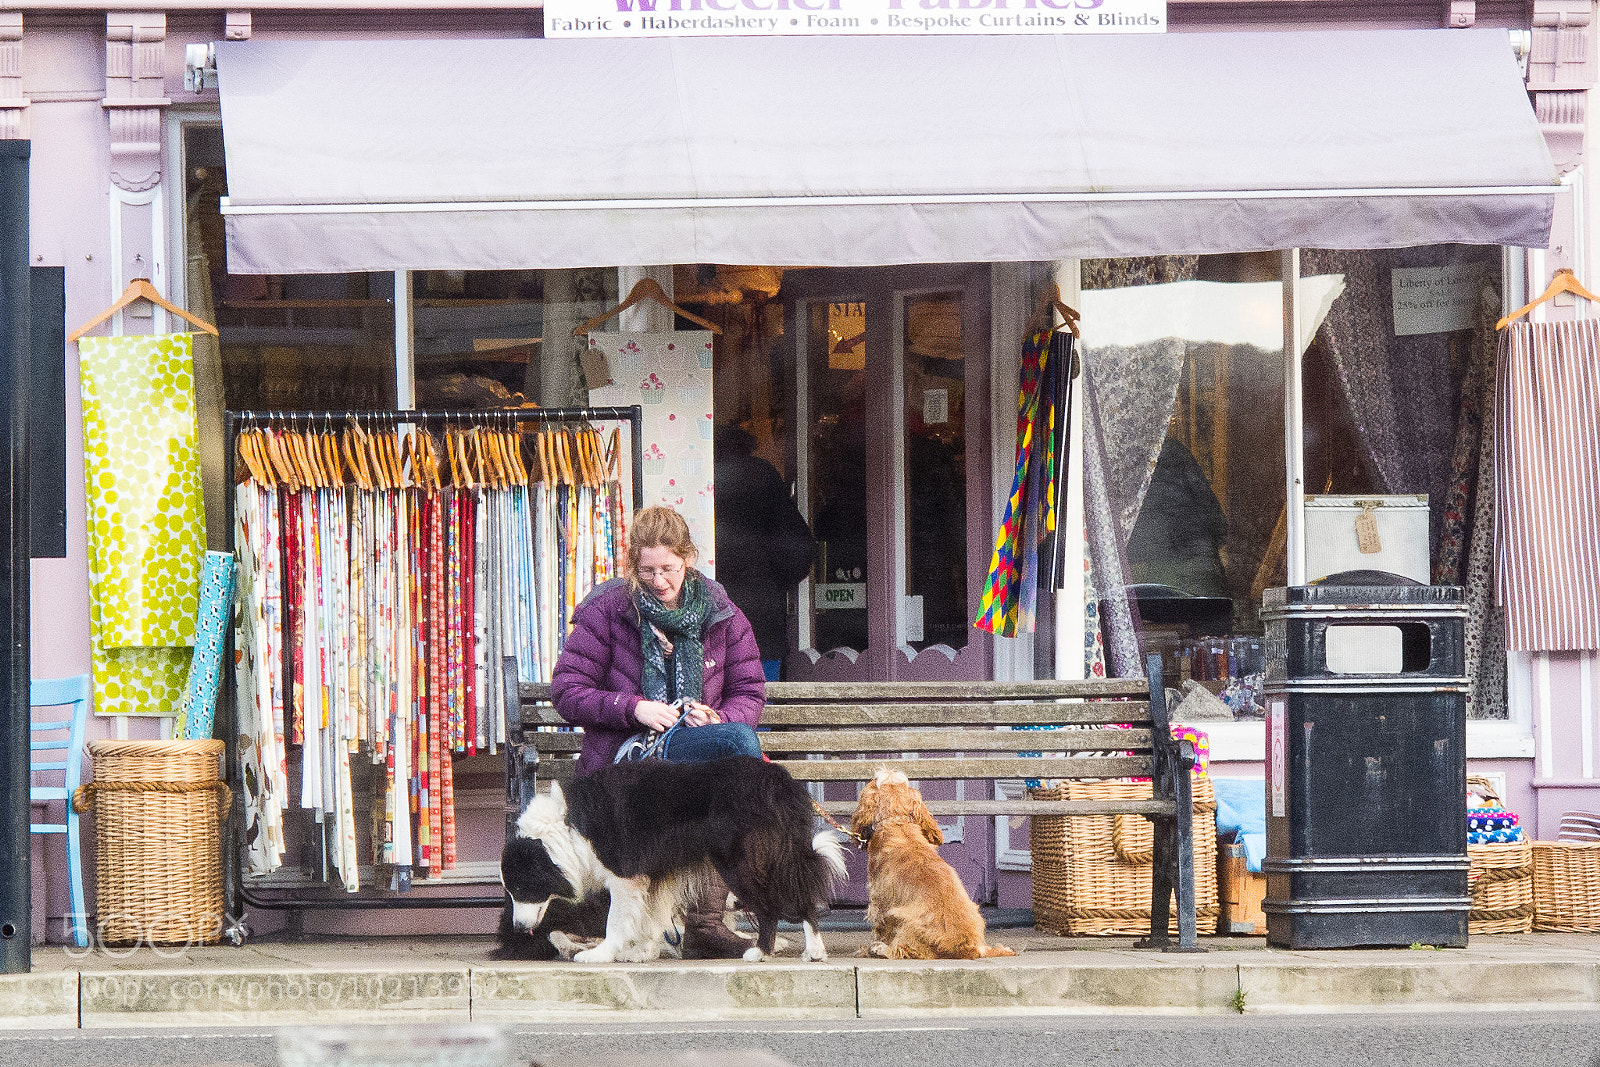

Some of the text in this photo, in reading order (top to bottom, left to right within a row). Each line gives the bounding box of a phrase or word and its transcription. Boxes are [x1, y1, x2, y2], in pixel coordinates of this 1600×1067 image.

[551, 12, 1160, 32] Fabric Haberdashery Foam Bespoke Curtains & Blinds
[825, 589, 854, 601] OPEN
